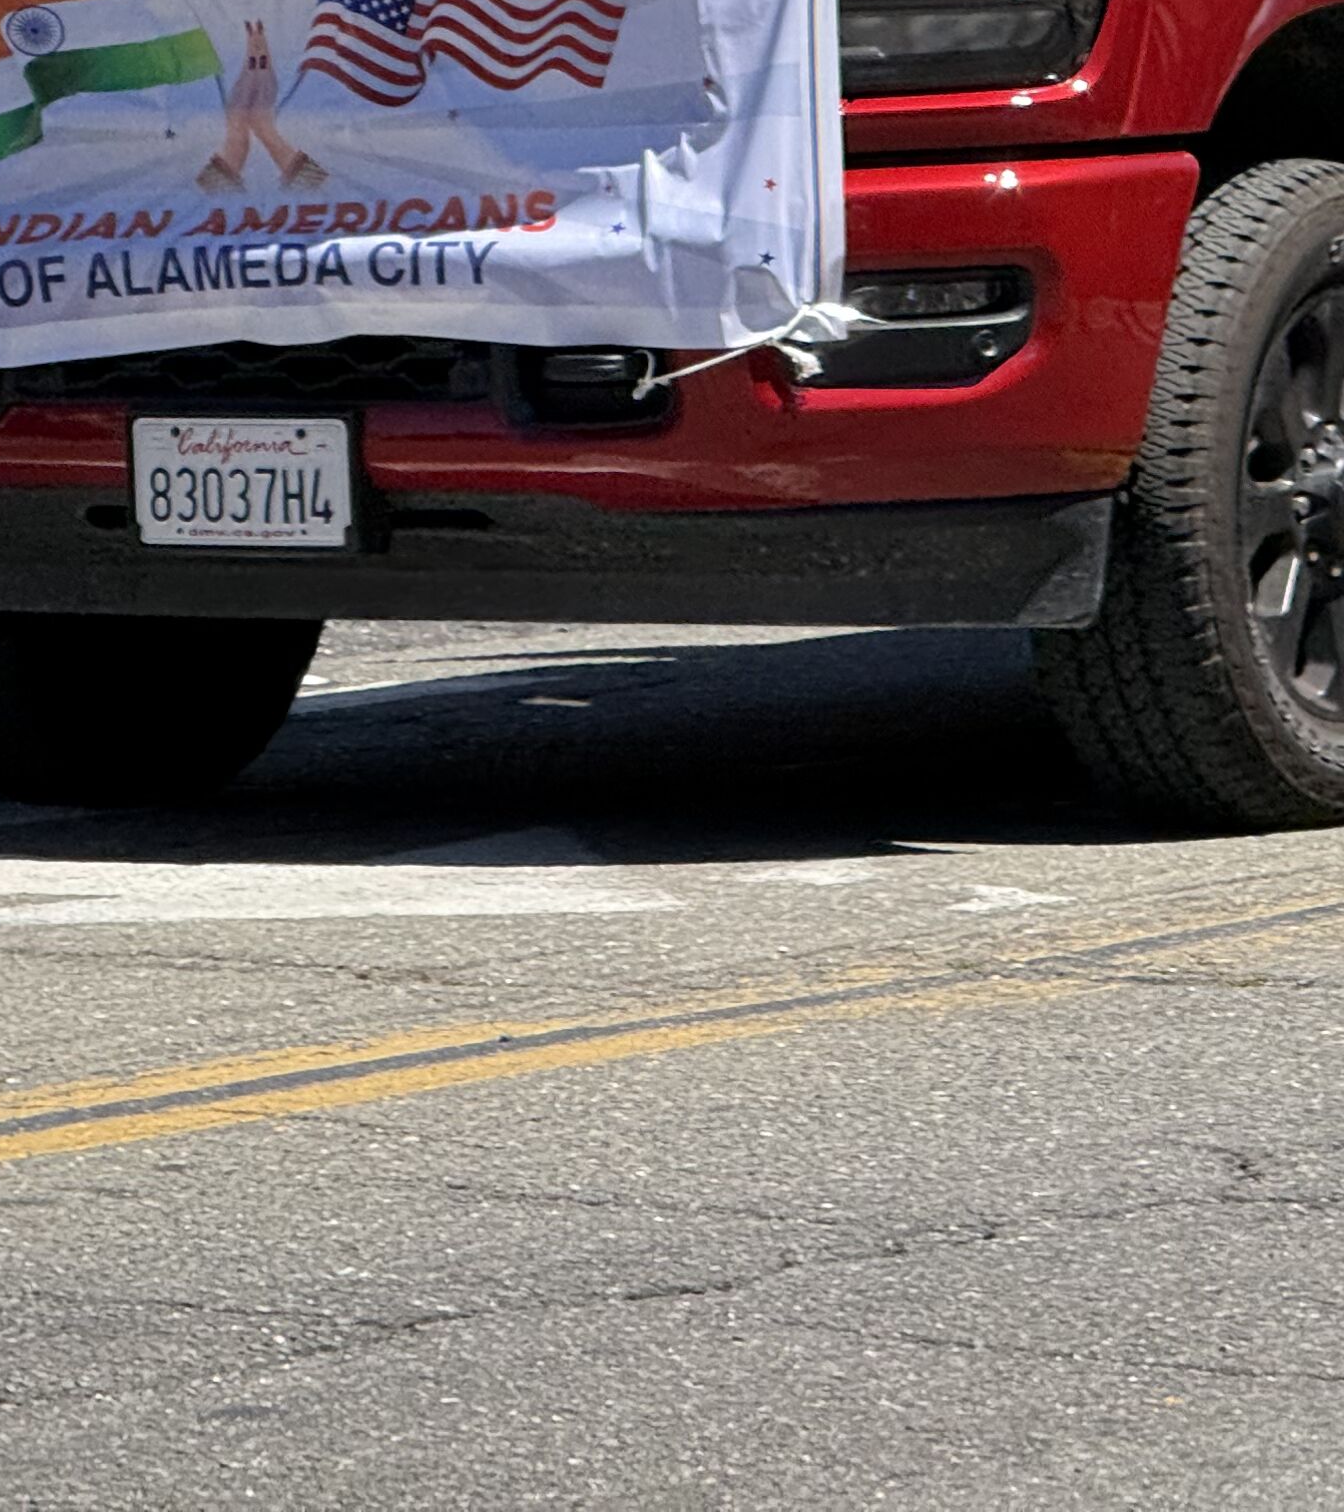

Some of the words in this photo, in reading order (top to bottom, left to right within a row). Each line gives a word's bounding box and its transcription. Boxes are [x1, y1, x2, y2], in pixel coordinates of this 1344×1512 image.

[185, 188, 558, 237] AMERICANS
[87, 242, 353, 300] ALAMEDA
[368, 241, 500, 287] CITY
[177, 427, 308, 464] California
[150, 467, 335, 524] 83037H4
